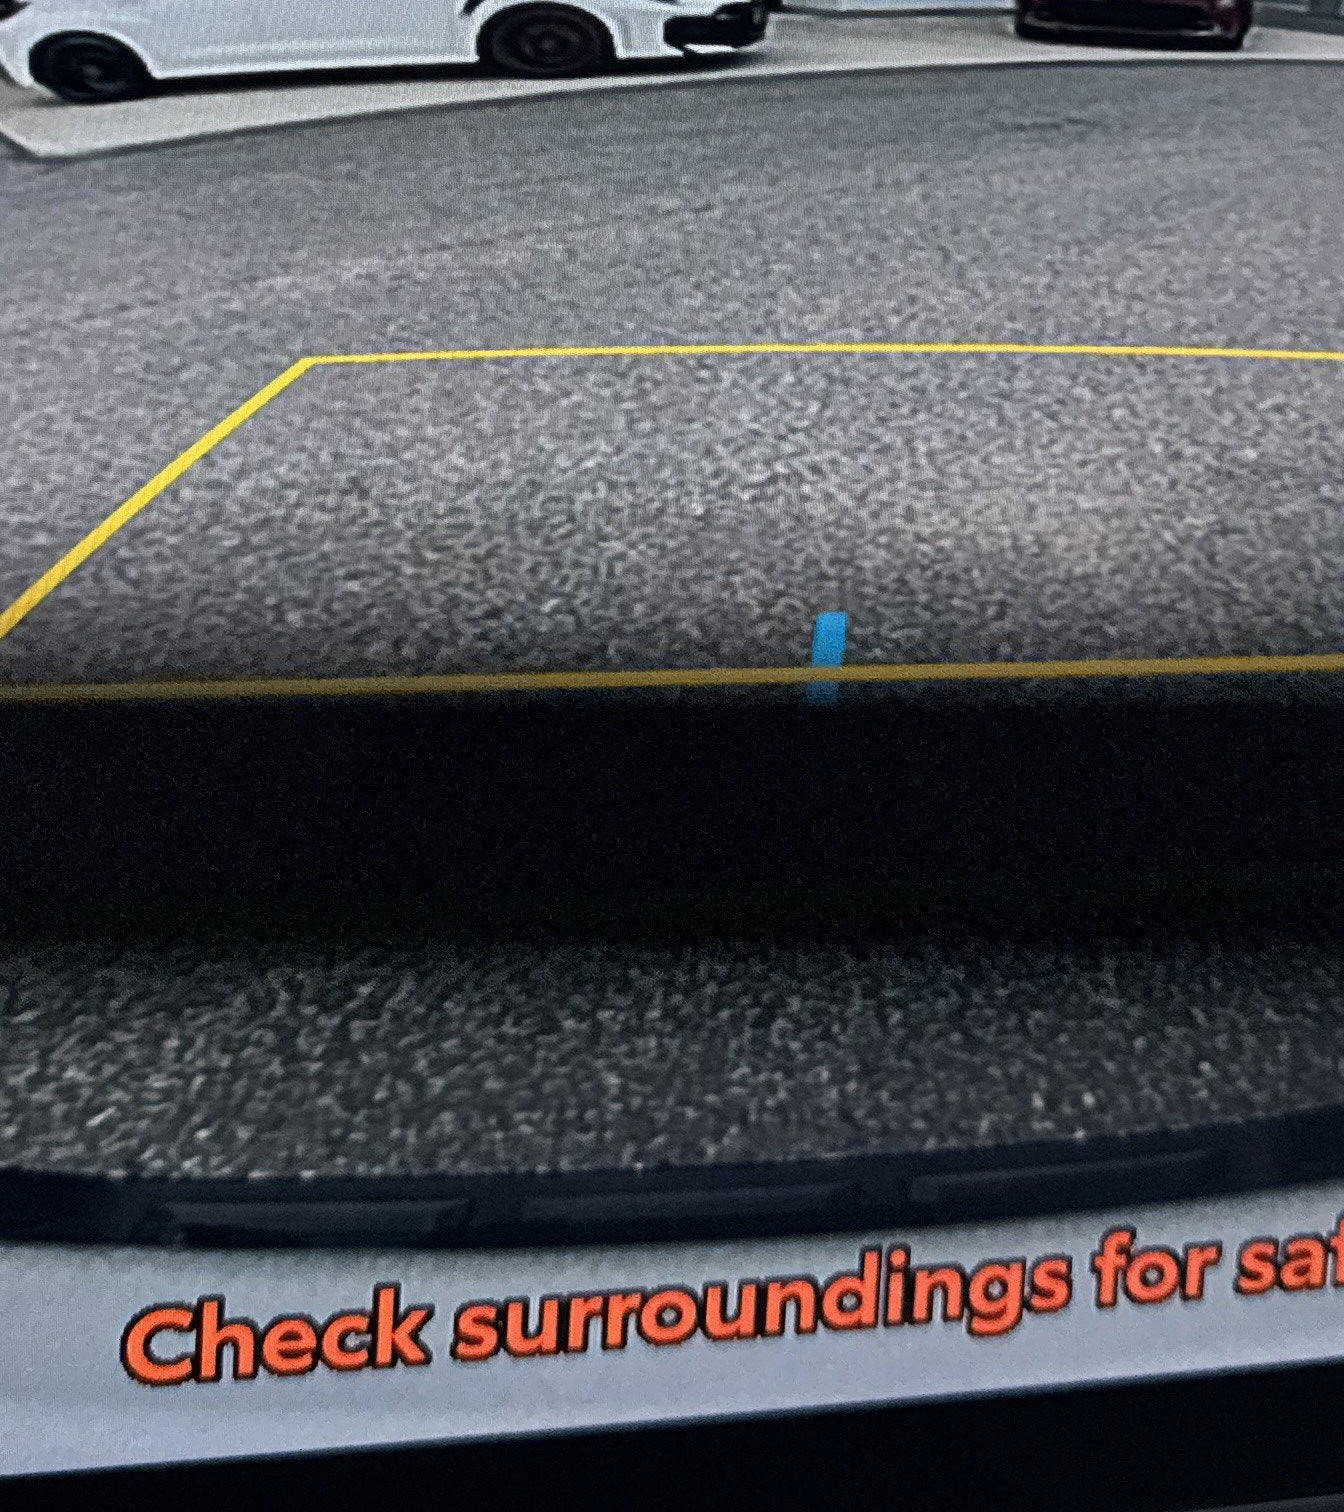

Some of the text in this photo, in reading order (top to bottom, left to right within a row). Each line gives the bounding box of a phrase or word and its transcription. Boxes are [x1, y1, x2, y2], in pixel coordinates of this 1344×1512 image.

[119, 1281, 435, 1386] Check
[450, 1242, 1074, 1363] surroundings
[1091, 1224, 1223, 1309] for
